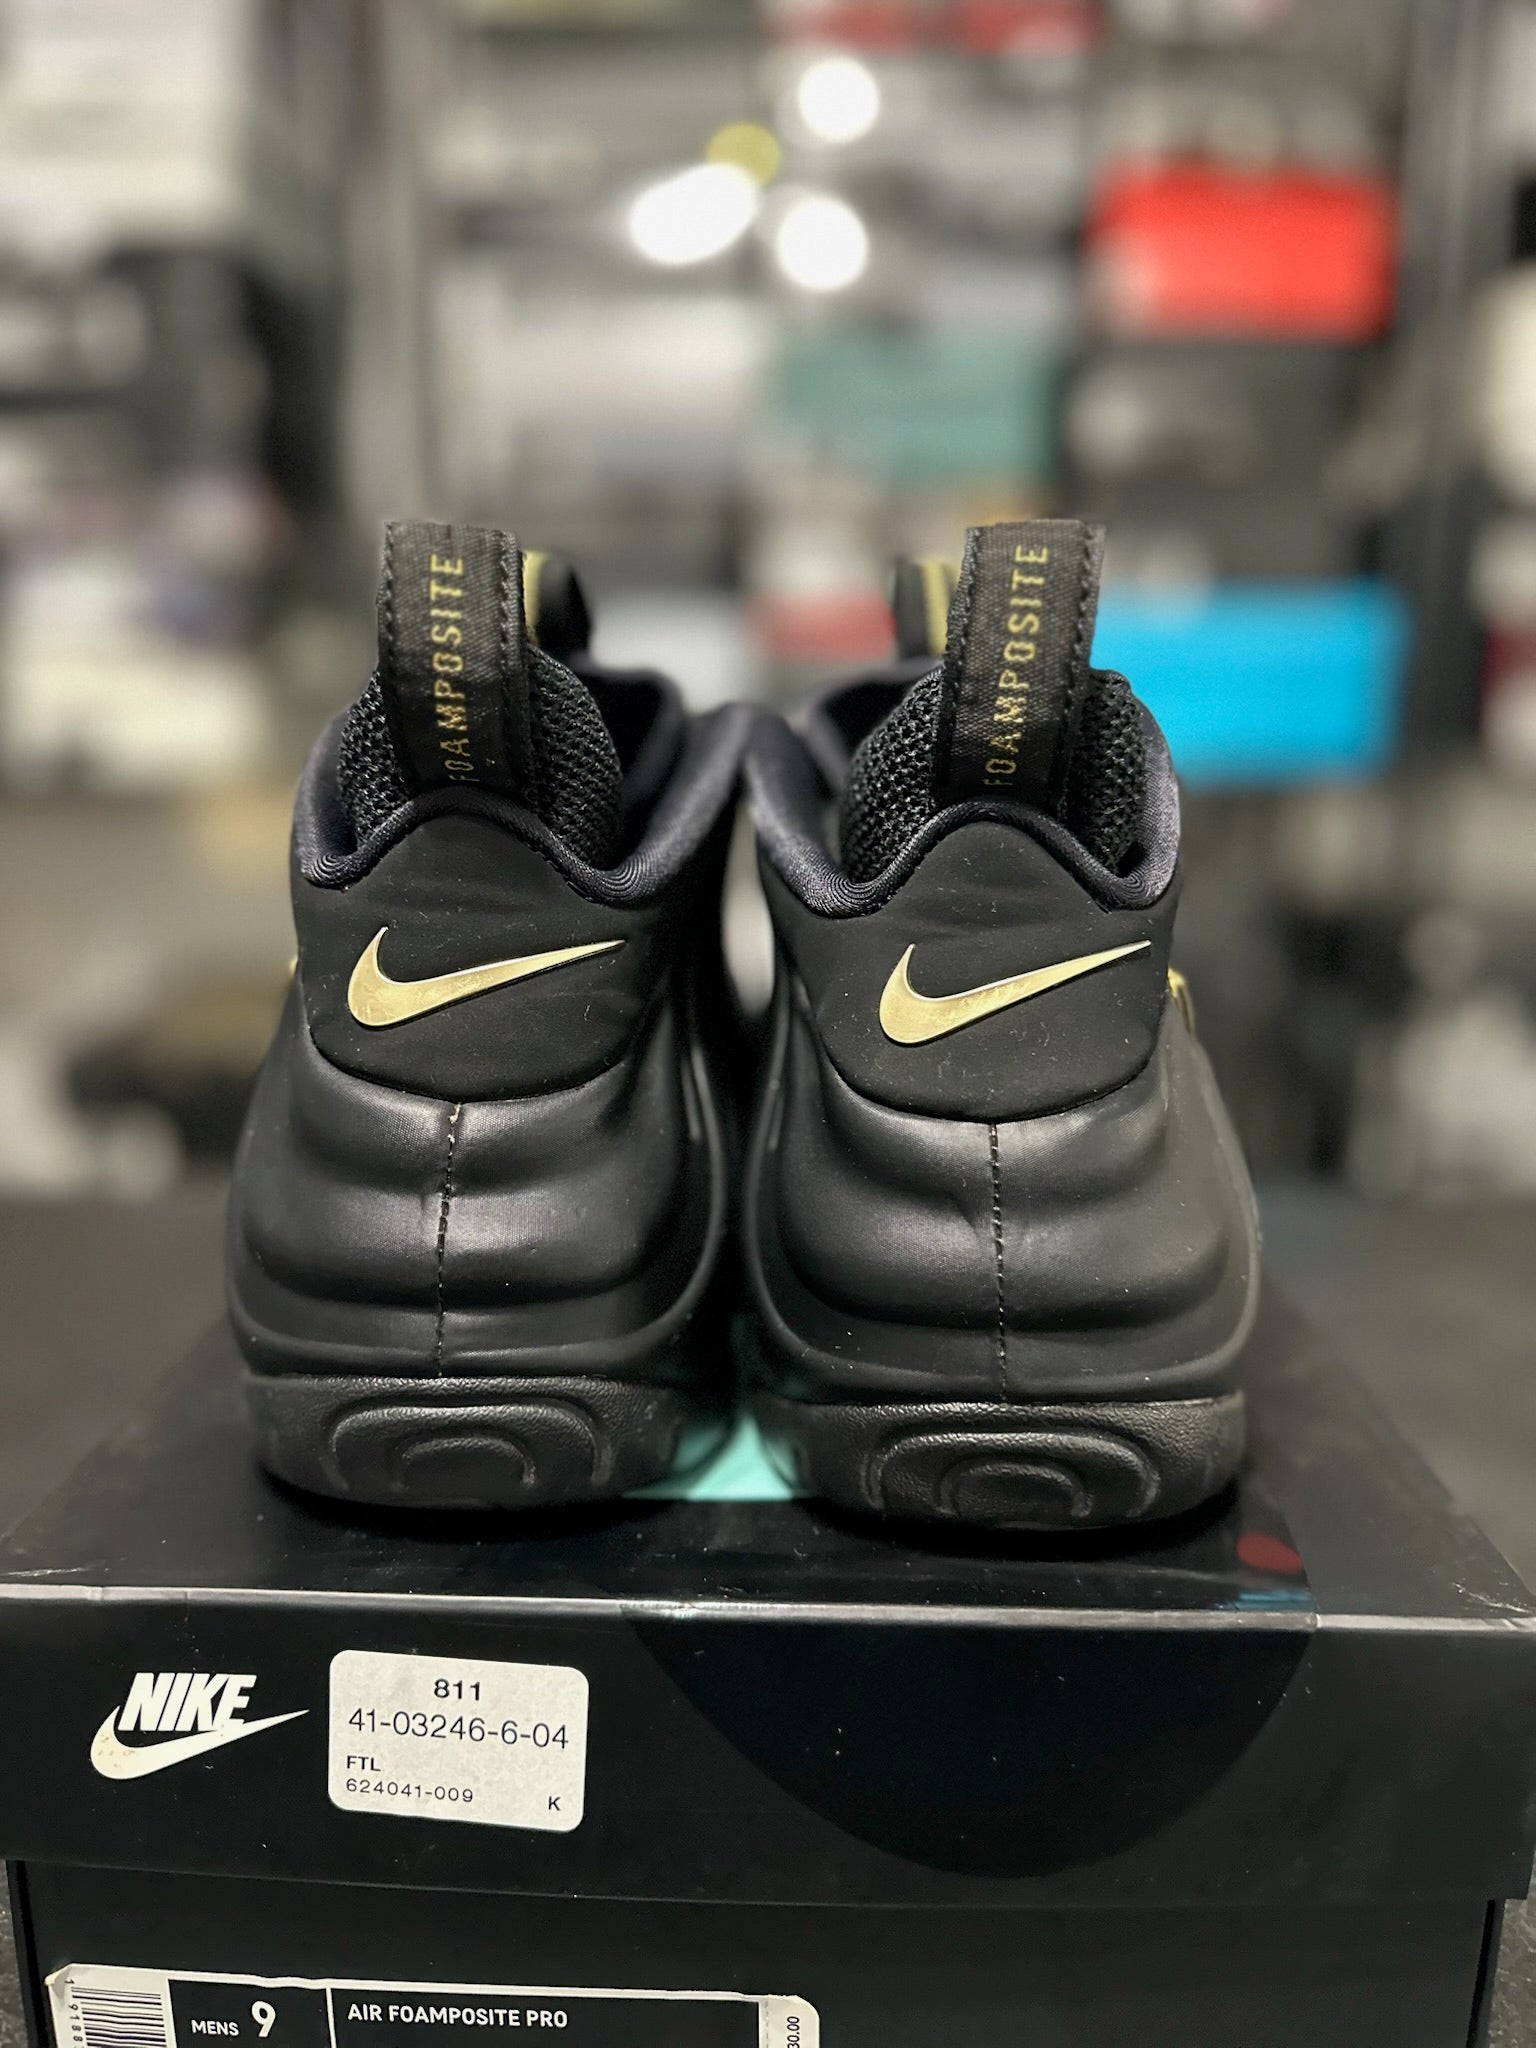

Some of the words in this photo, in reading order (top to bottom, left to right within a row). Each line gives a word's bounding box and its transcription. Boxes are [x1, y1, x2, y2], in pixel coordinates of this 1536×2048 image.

[430, 554, 480, 782] FOAMPOSITE
[984, 545, 1048, 786] FOAMPOSITE
[118, 1672, 257, 1732] NIKE
[434, 1679, 481, 1702] 811
[348, 1707, 569, 1750] 41-03246-6-04
[346, 1755, 381, 1772] FTL
[345, 1778, 474, 1803] 624041-009
[547, 1796, 561, 1812] K
[68, 2003, 84, 2048] 9188
[191, 2019, 240, 2037] MENS
[251, 2000, 276, 2038] 9
[347, 2003, 382, 2022] AIR
[388, 2005, 521, 2027] FOAMPOSITE
[526, 2009, 568, 2028] PRO
